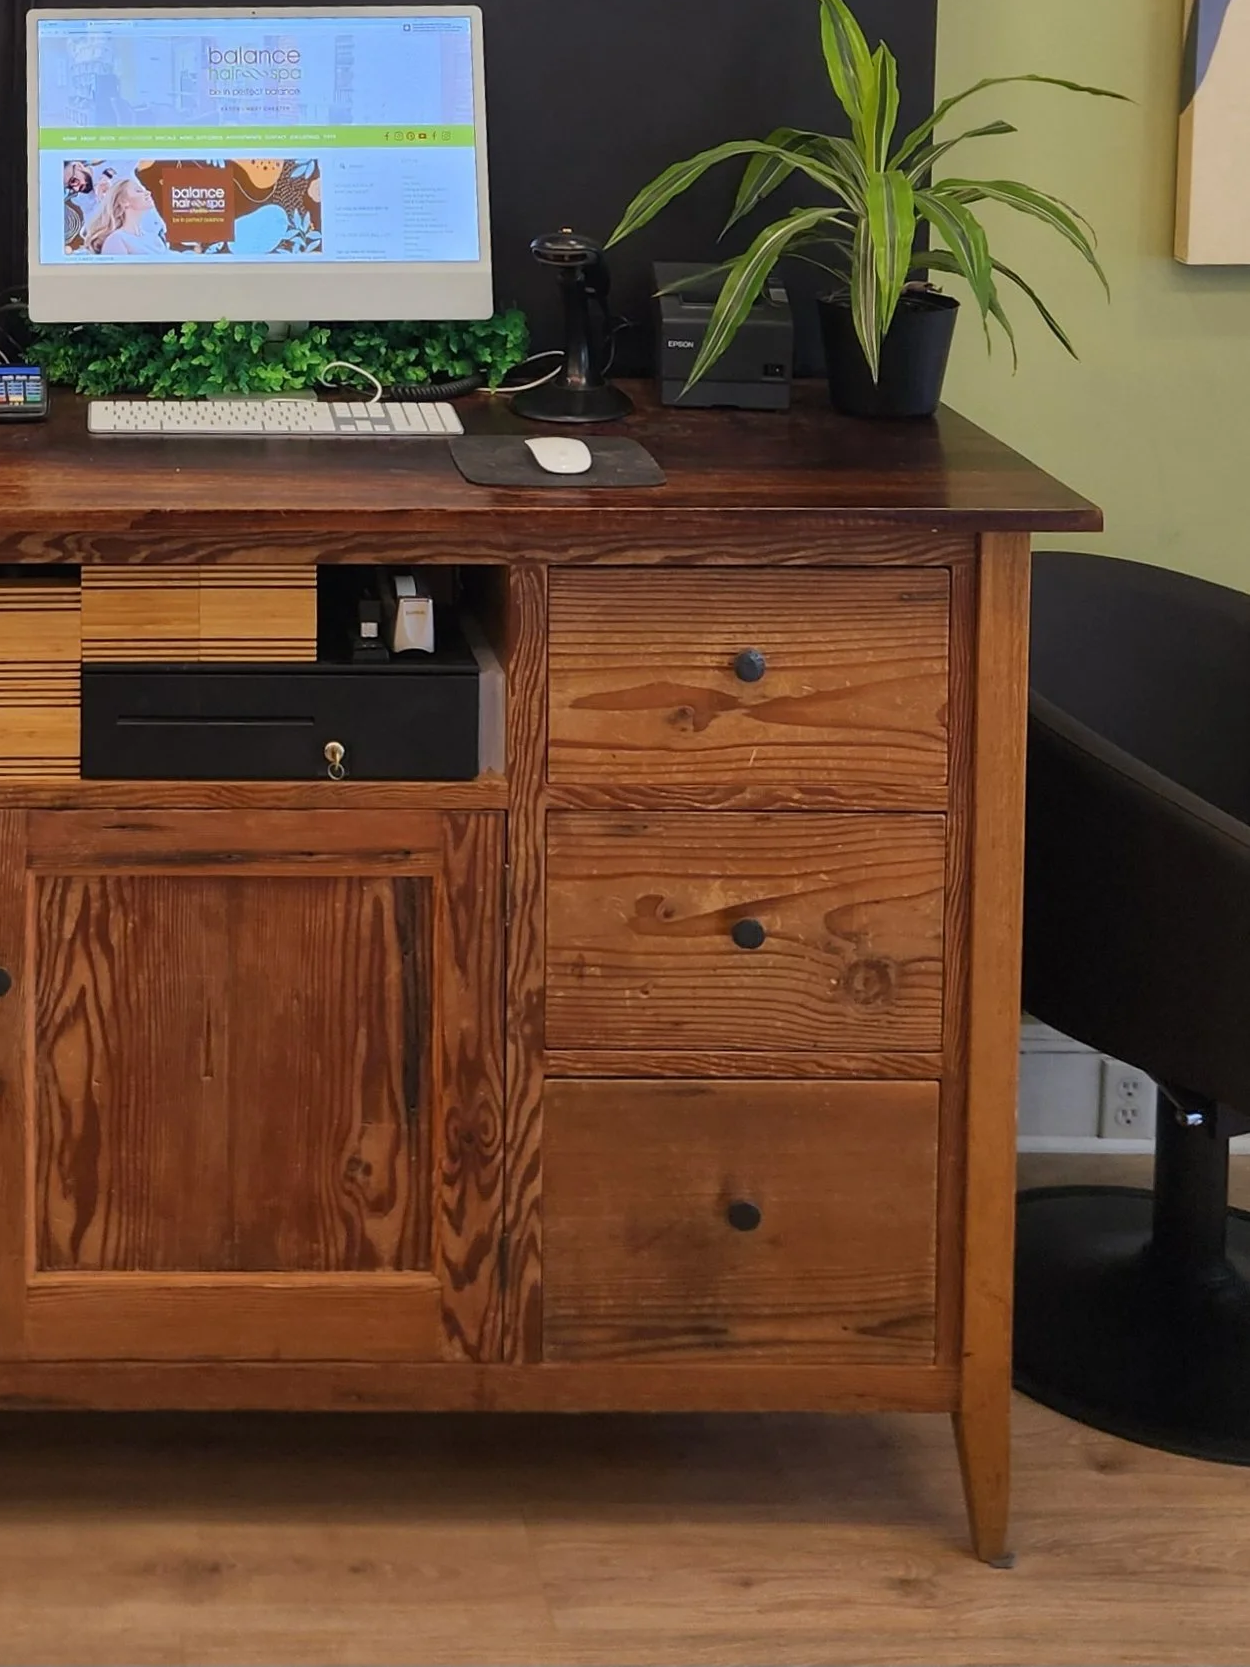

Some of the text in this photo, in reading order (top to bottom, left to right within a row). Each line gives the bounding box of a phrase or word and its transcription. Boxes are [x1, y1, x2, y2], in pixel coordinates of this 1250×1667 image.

[208, 46, 301, 65] balance
[208, 66, 302, 83] hair spa
[171, 186, 225, 199] balance
[171, 198, 191, 208] hair
